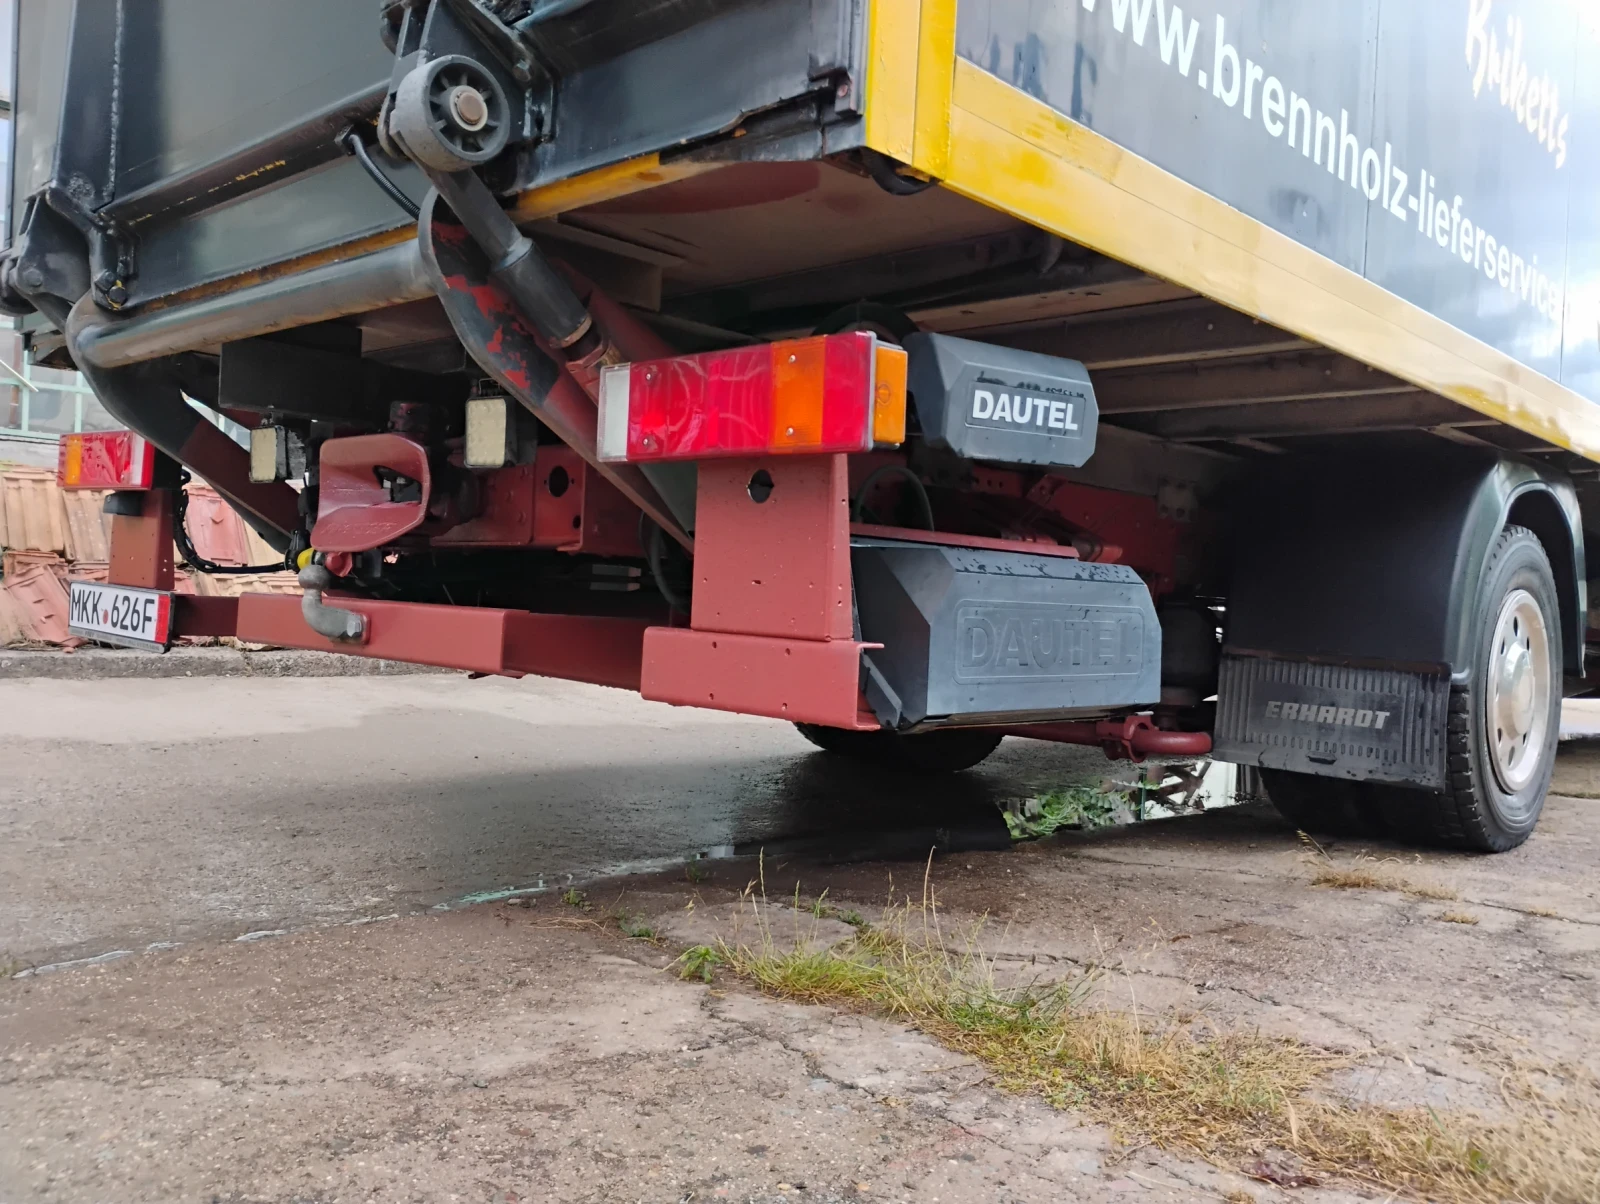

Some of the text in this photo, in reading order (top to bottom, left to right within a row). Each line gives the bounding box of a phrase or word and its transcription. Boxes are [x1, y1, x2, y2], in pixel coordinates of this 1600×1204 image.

[1082, 0, 1559, 321] ww.brennholz-lieferservice
[972, 390, 1078, 431] DAUTEL
[71, 588, 155, 633] MKK 626F
[963, 616, 1137, 668] DAUTEL
[1265, 701, 1390, 729] ERHARDT
